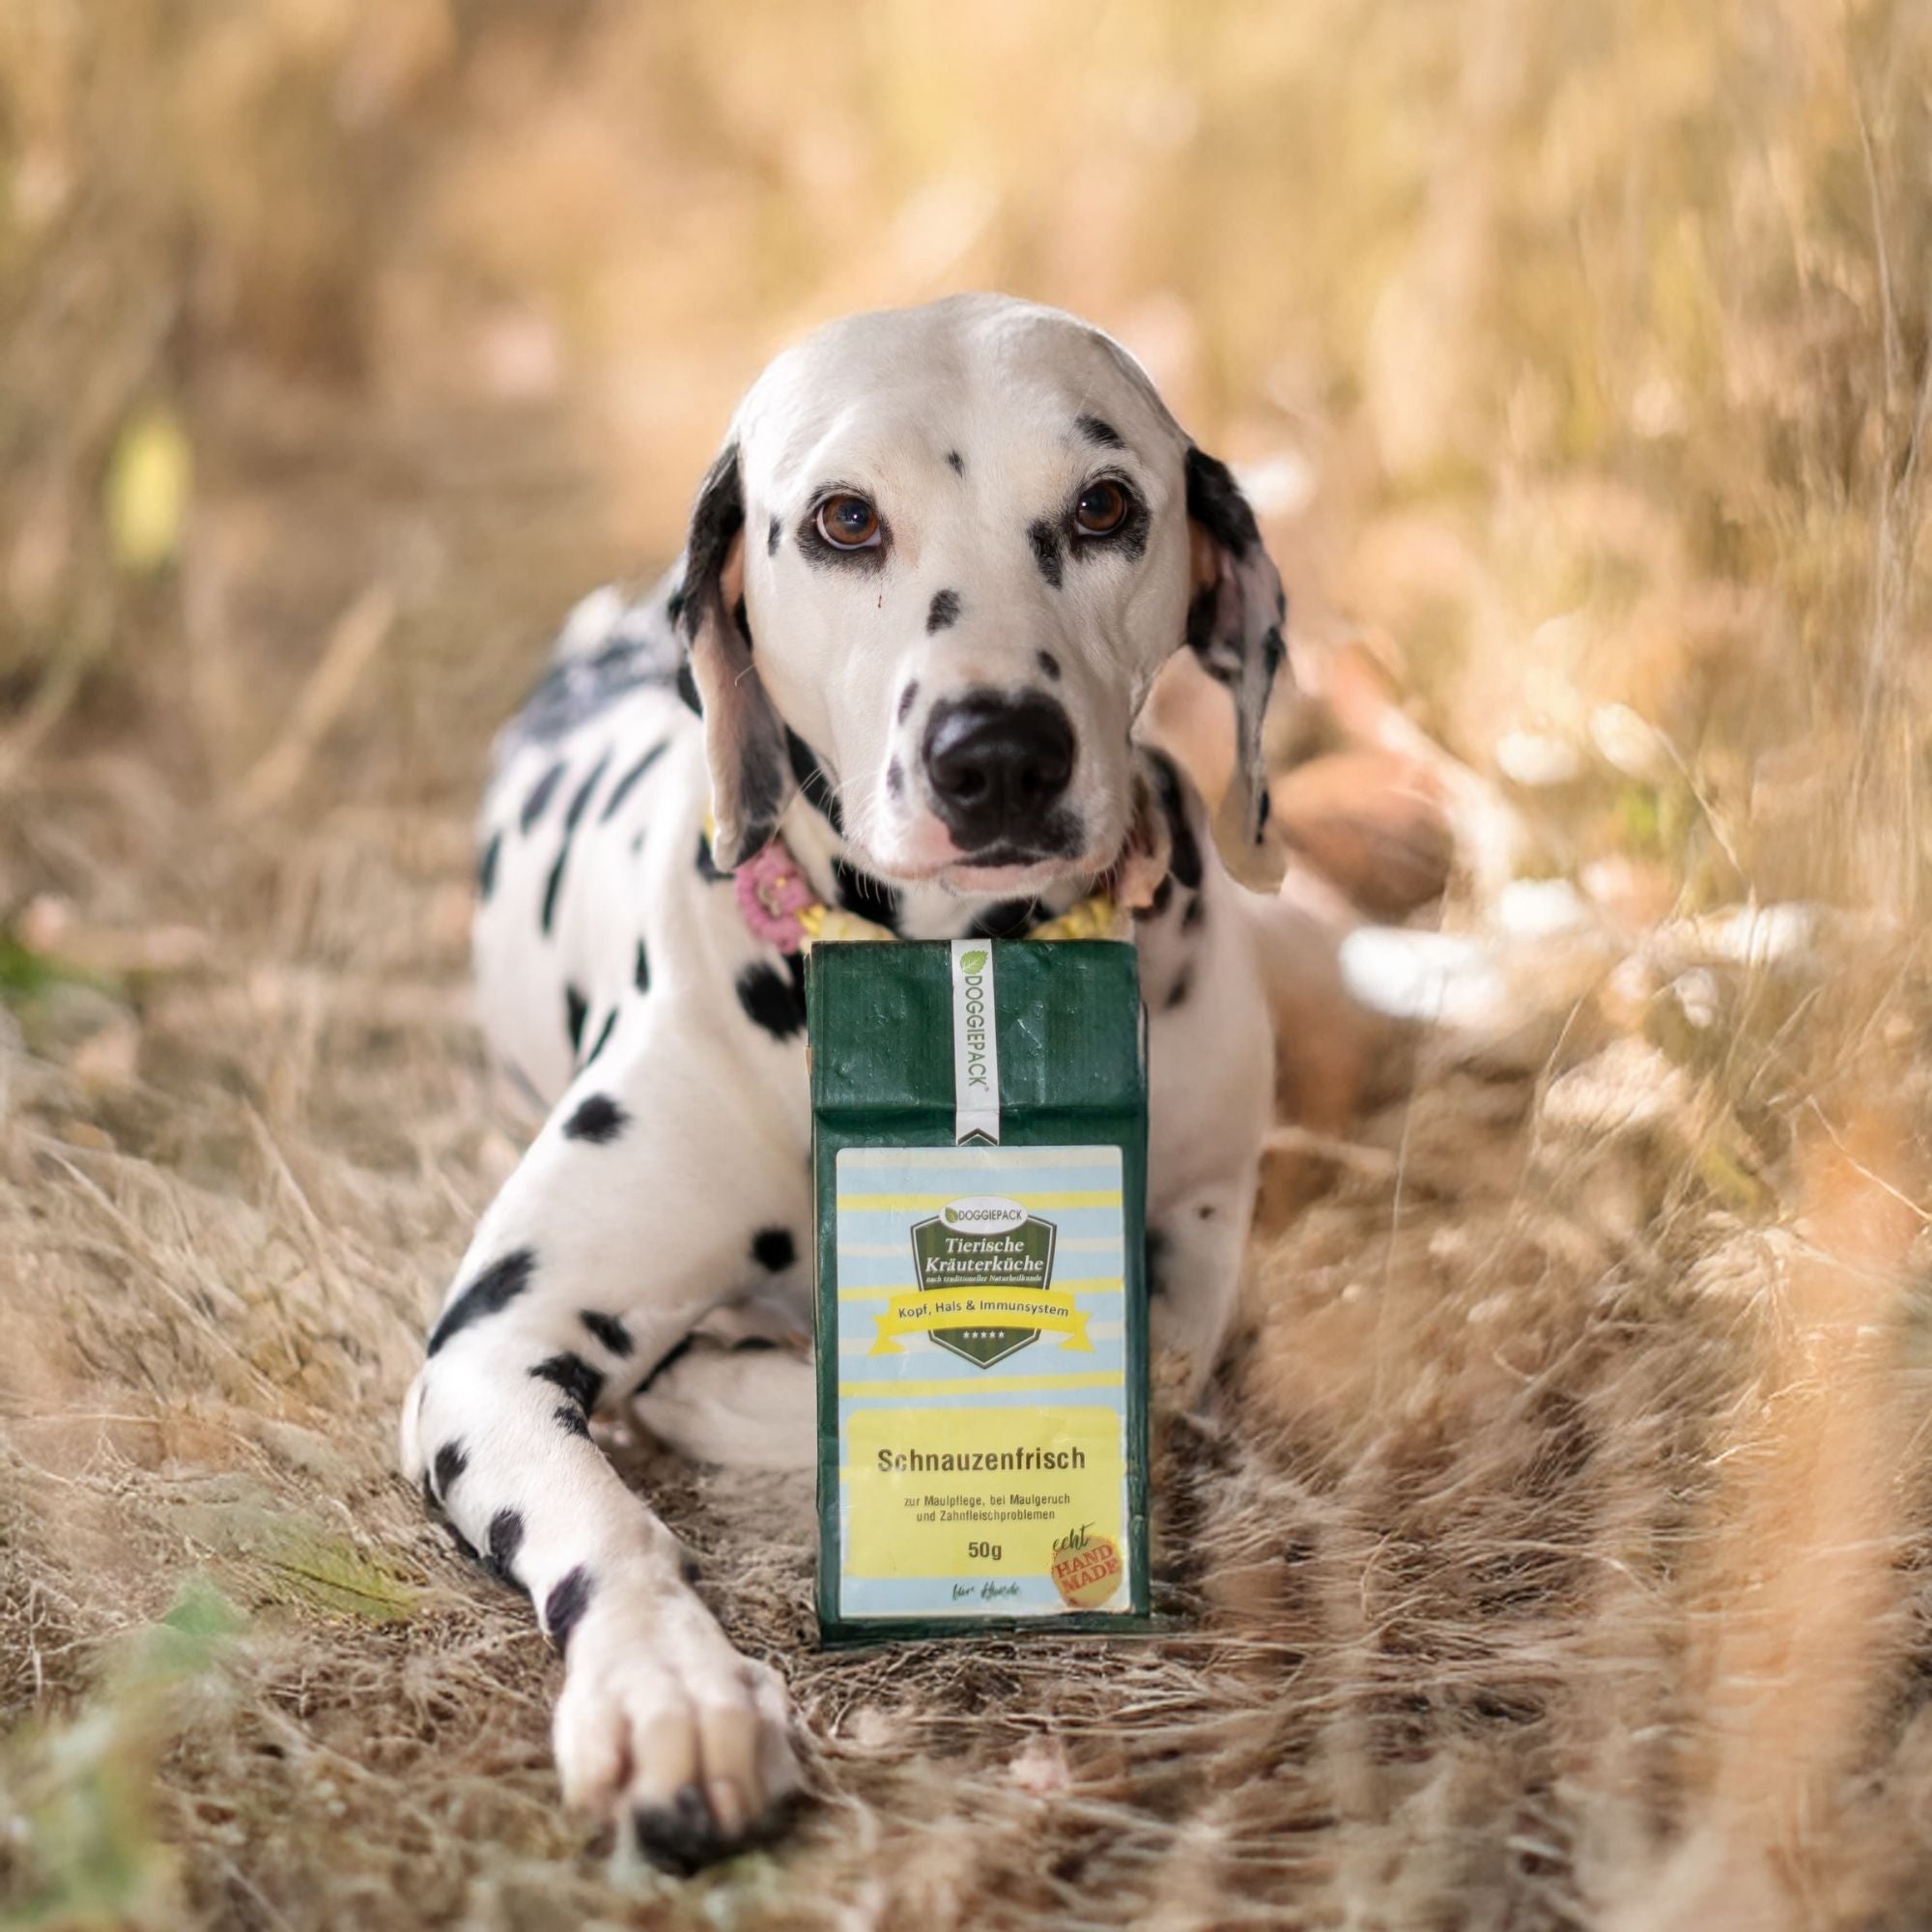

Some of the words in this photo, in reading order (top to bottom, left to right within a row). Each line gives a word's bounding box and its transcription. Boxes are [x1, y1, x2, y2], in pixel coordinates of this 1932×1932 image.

[964, 976, 987, 1087] DOGGIEPACK
[958, 1209, 1022, 1221] DOGGIEPACK
[945, 1236, 1024, 1253] Tierische
[925, 1256, 1043, 1272] Kräuterküche
[898, 1304, 931, 1318] Kopf,
[936, 1300, 961, 1313] Hals
[966, 1299, 975, 1310] &
[980, 1300, 1068, 1317] Immunsystem
[877, 1447, 1086, 1472] Schnauzenfrisch
[904, 1497, 920, 1507] zur
[924, 1494, 985, 1508] Maulpflege,
[990, 1494, 1006, 1505] bei
[1009, 1493, 1070, 1507] Maulgeruch
[917, 1511, 935, 1522] und
[940, 1509, 1055, 1521] Zahnfleischproblemen
[1052, 1522, 1095, 1552] echt
[968, 1542, 1002, 1560] 50g
[1055, 1544, 1114, 1578] HAND
[1062, 1557, 1120, 1593] MADE
